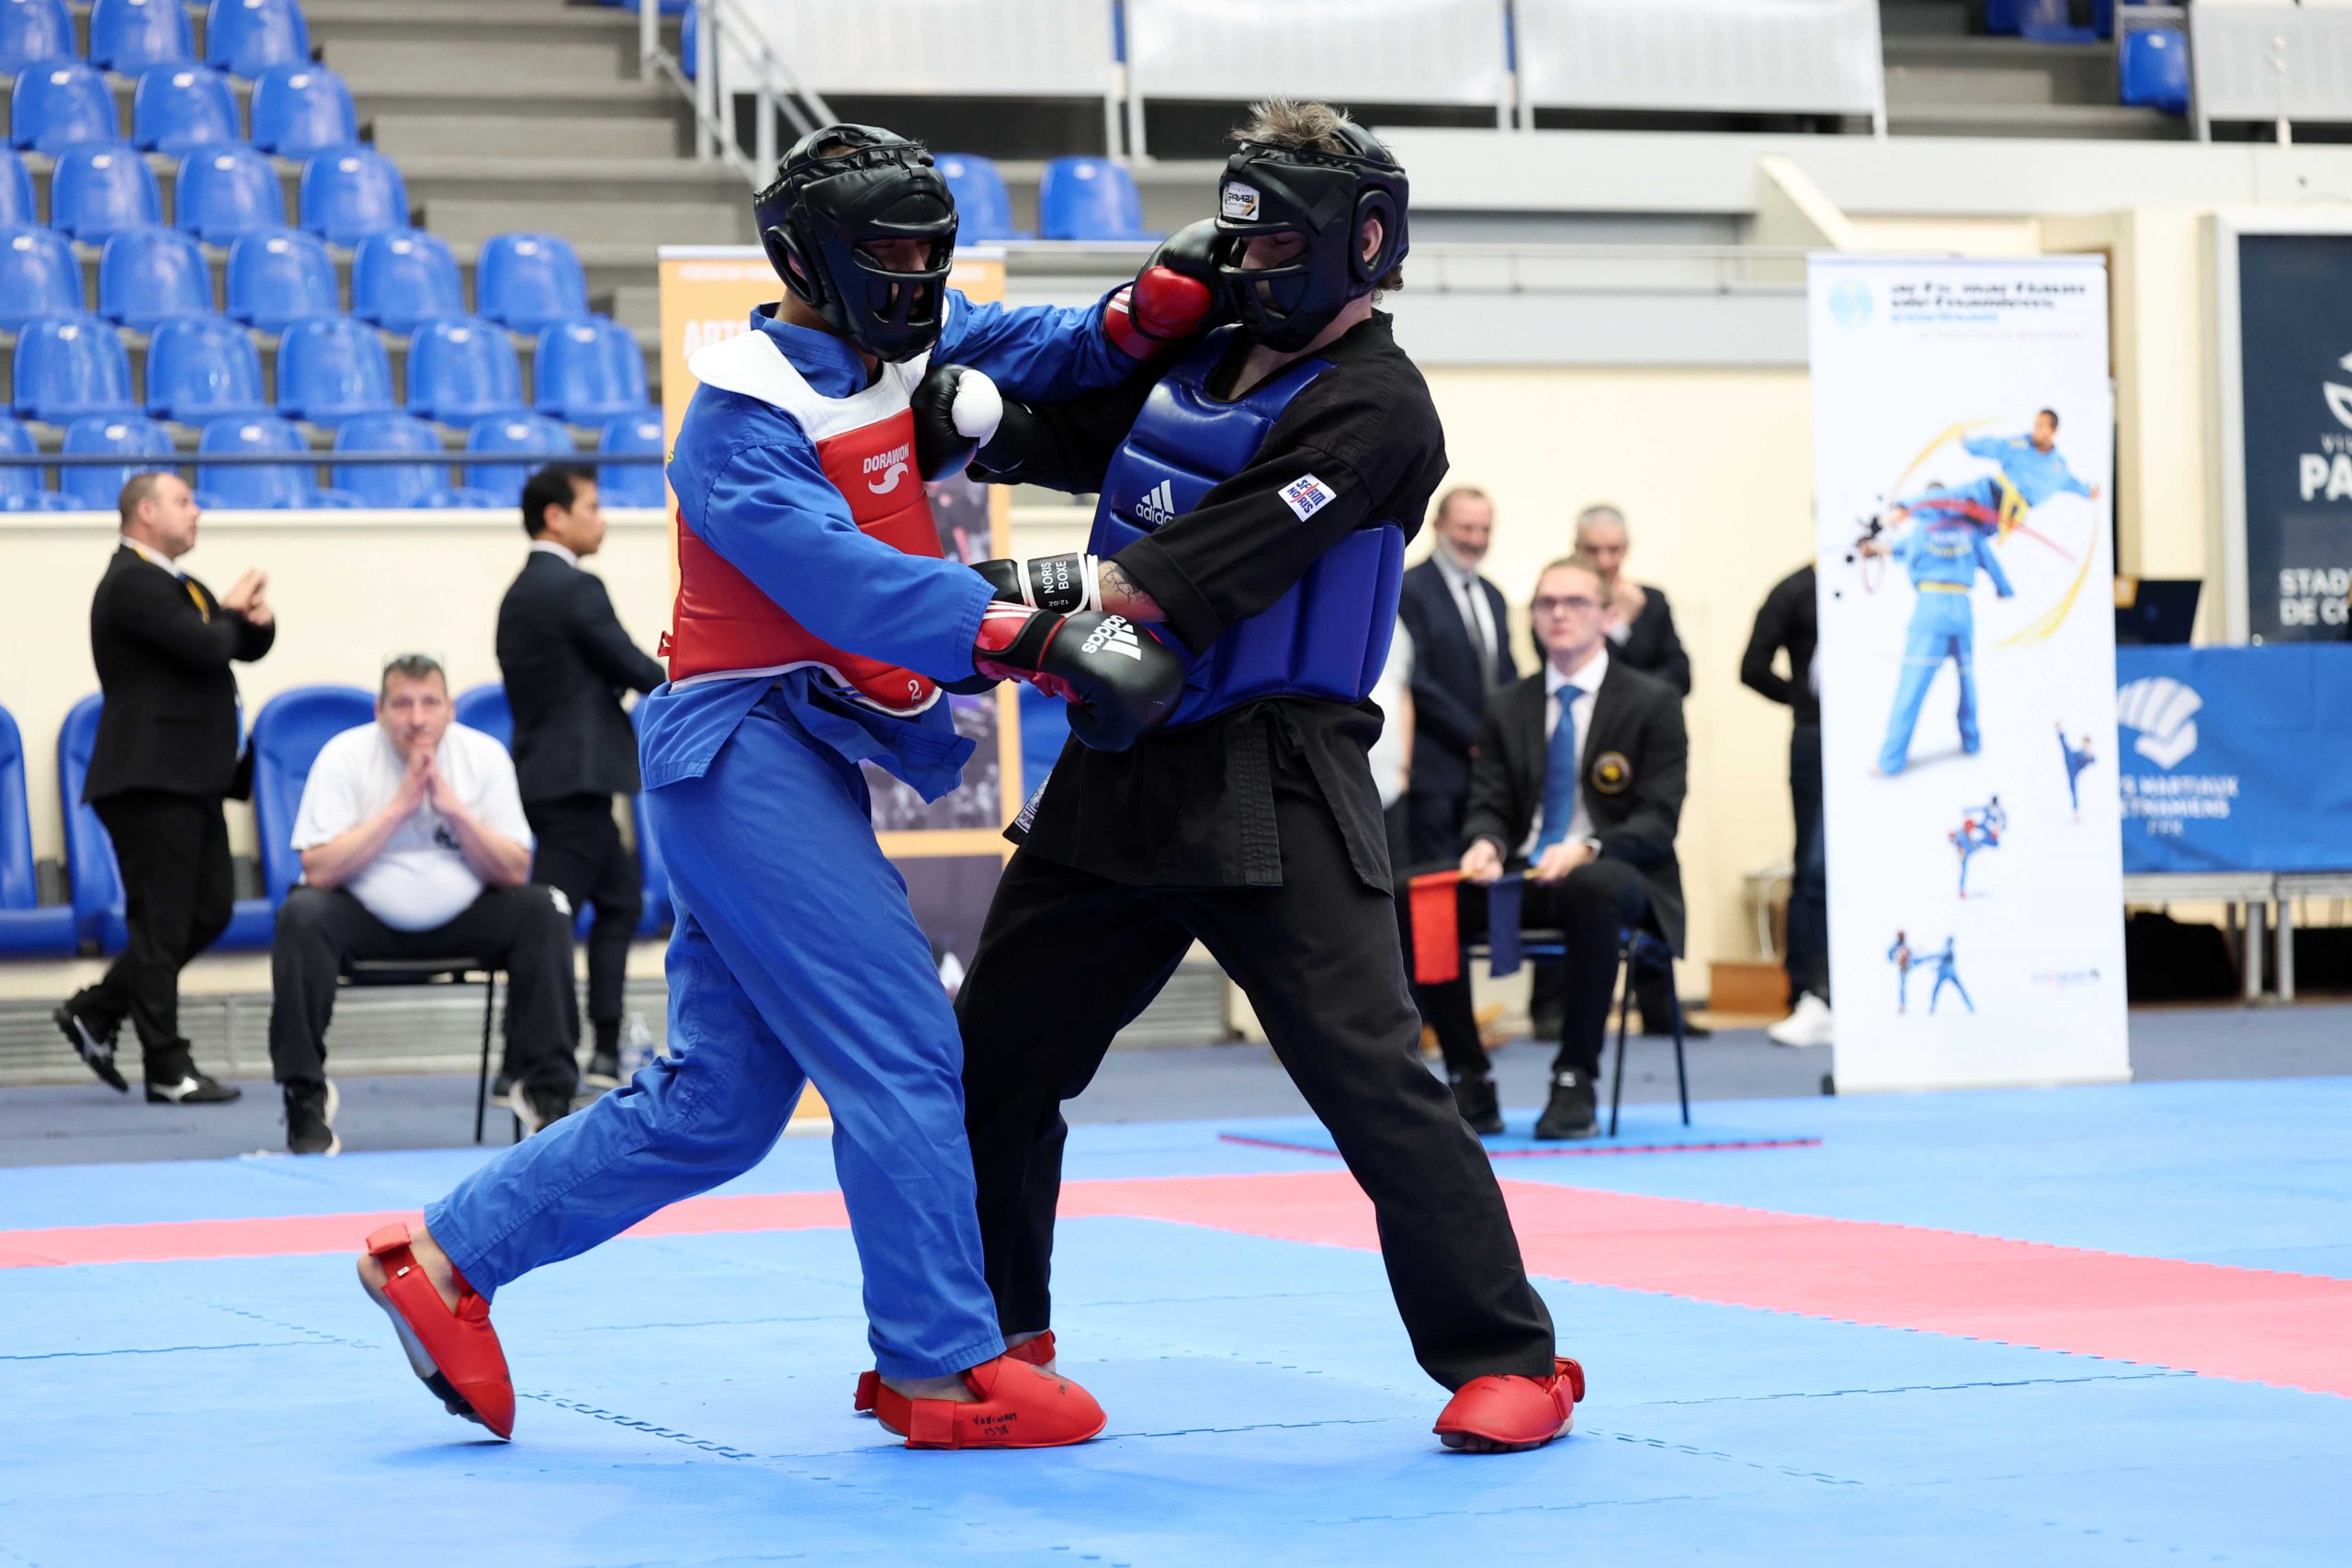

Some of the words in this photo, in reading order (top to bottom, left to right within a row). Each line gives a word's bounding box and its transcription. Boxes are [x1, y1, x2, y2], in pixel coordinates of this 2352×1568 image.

[683, 319, 751, 360] ART
[863, 442, 910, 474] DORAWON
[1136, 503, 1173, 525] adida
[1040, 561, 1055, 594] NORIS
[1056, 560, 1069, 591] BOXE
[2278, 567, 2351, 597] STAD
[1081, 615, 1126, 654] adidas
[908, 679, 922, 703] 2
